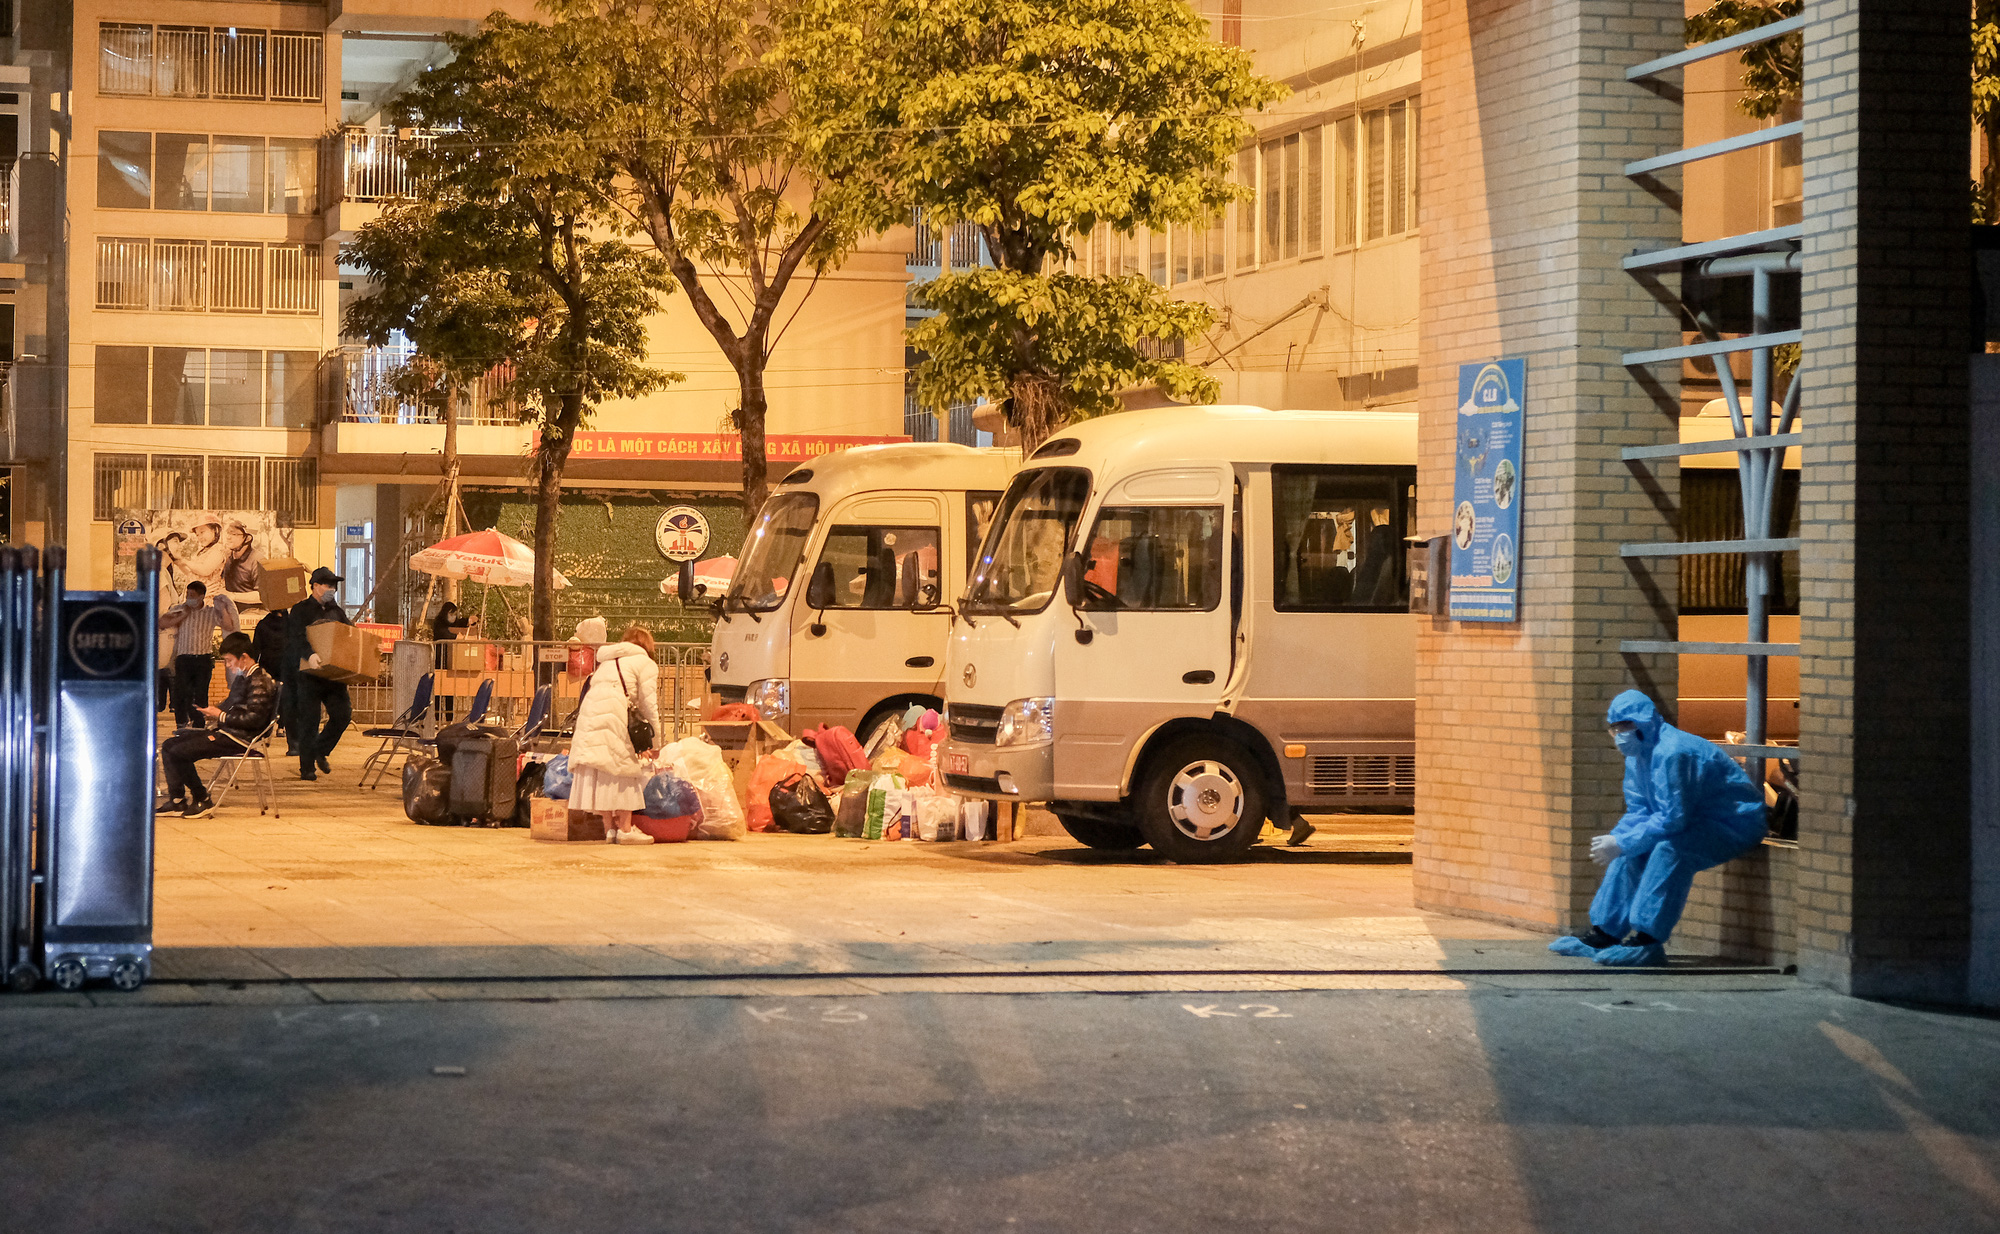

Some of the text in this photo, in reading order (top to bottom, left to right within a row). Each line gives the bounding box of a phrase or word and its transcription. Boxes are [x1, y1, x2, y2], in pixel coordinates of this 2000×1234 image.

[573, 438, 593, 454] ỌC
[597, 437, 616, 452] LÀ
[620, 438, 653, 455] MỘT
[657, 438, 698, 454] CÁCH
[702, 438, 731, 454] XÂY
[781, 441, 801, 455] XÃ
[454, 553, 505, 566] Yakult
[76, 633, 106, 649] SAFE
[1182, 1004, 1293, 1018] K2
